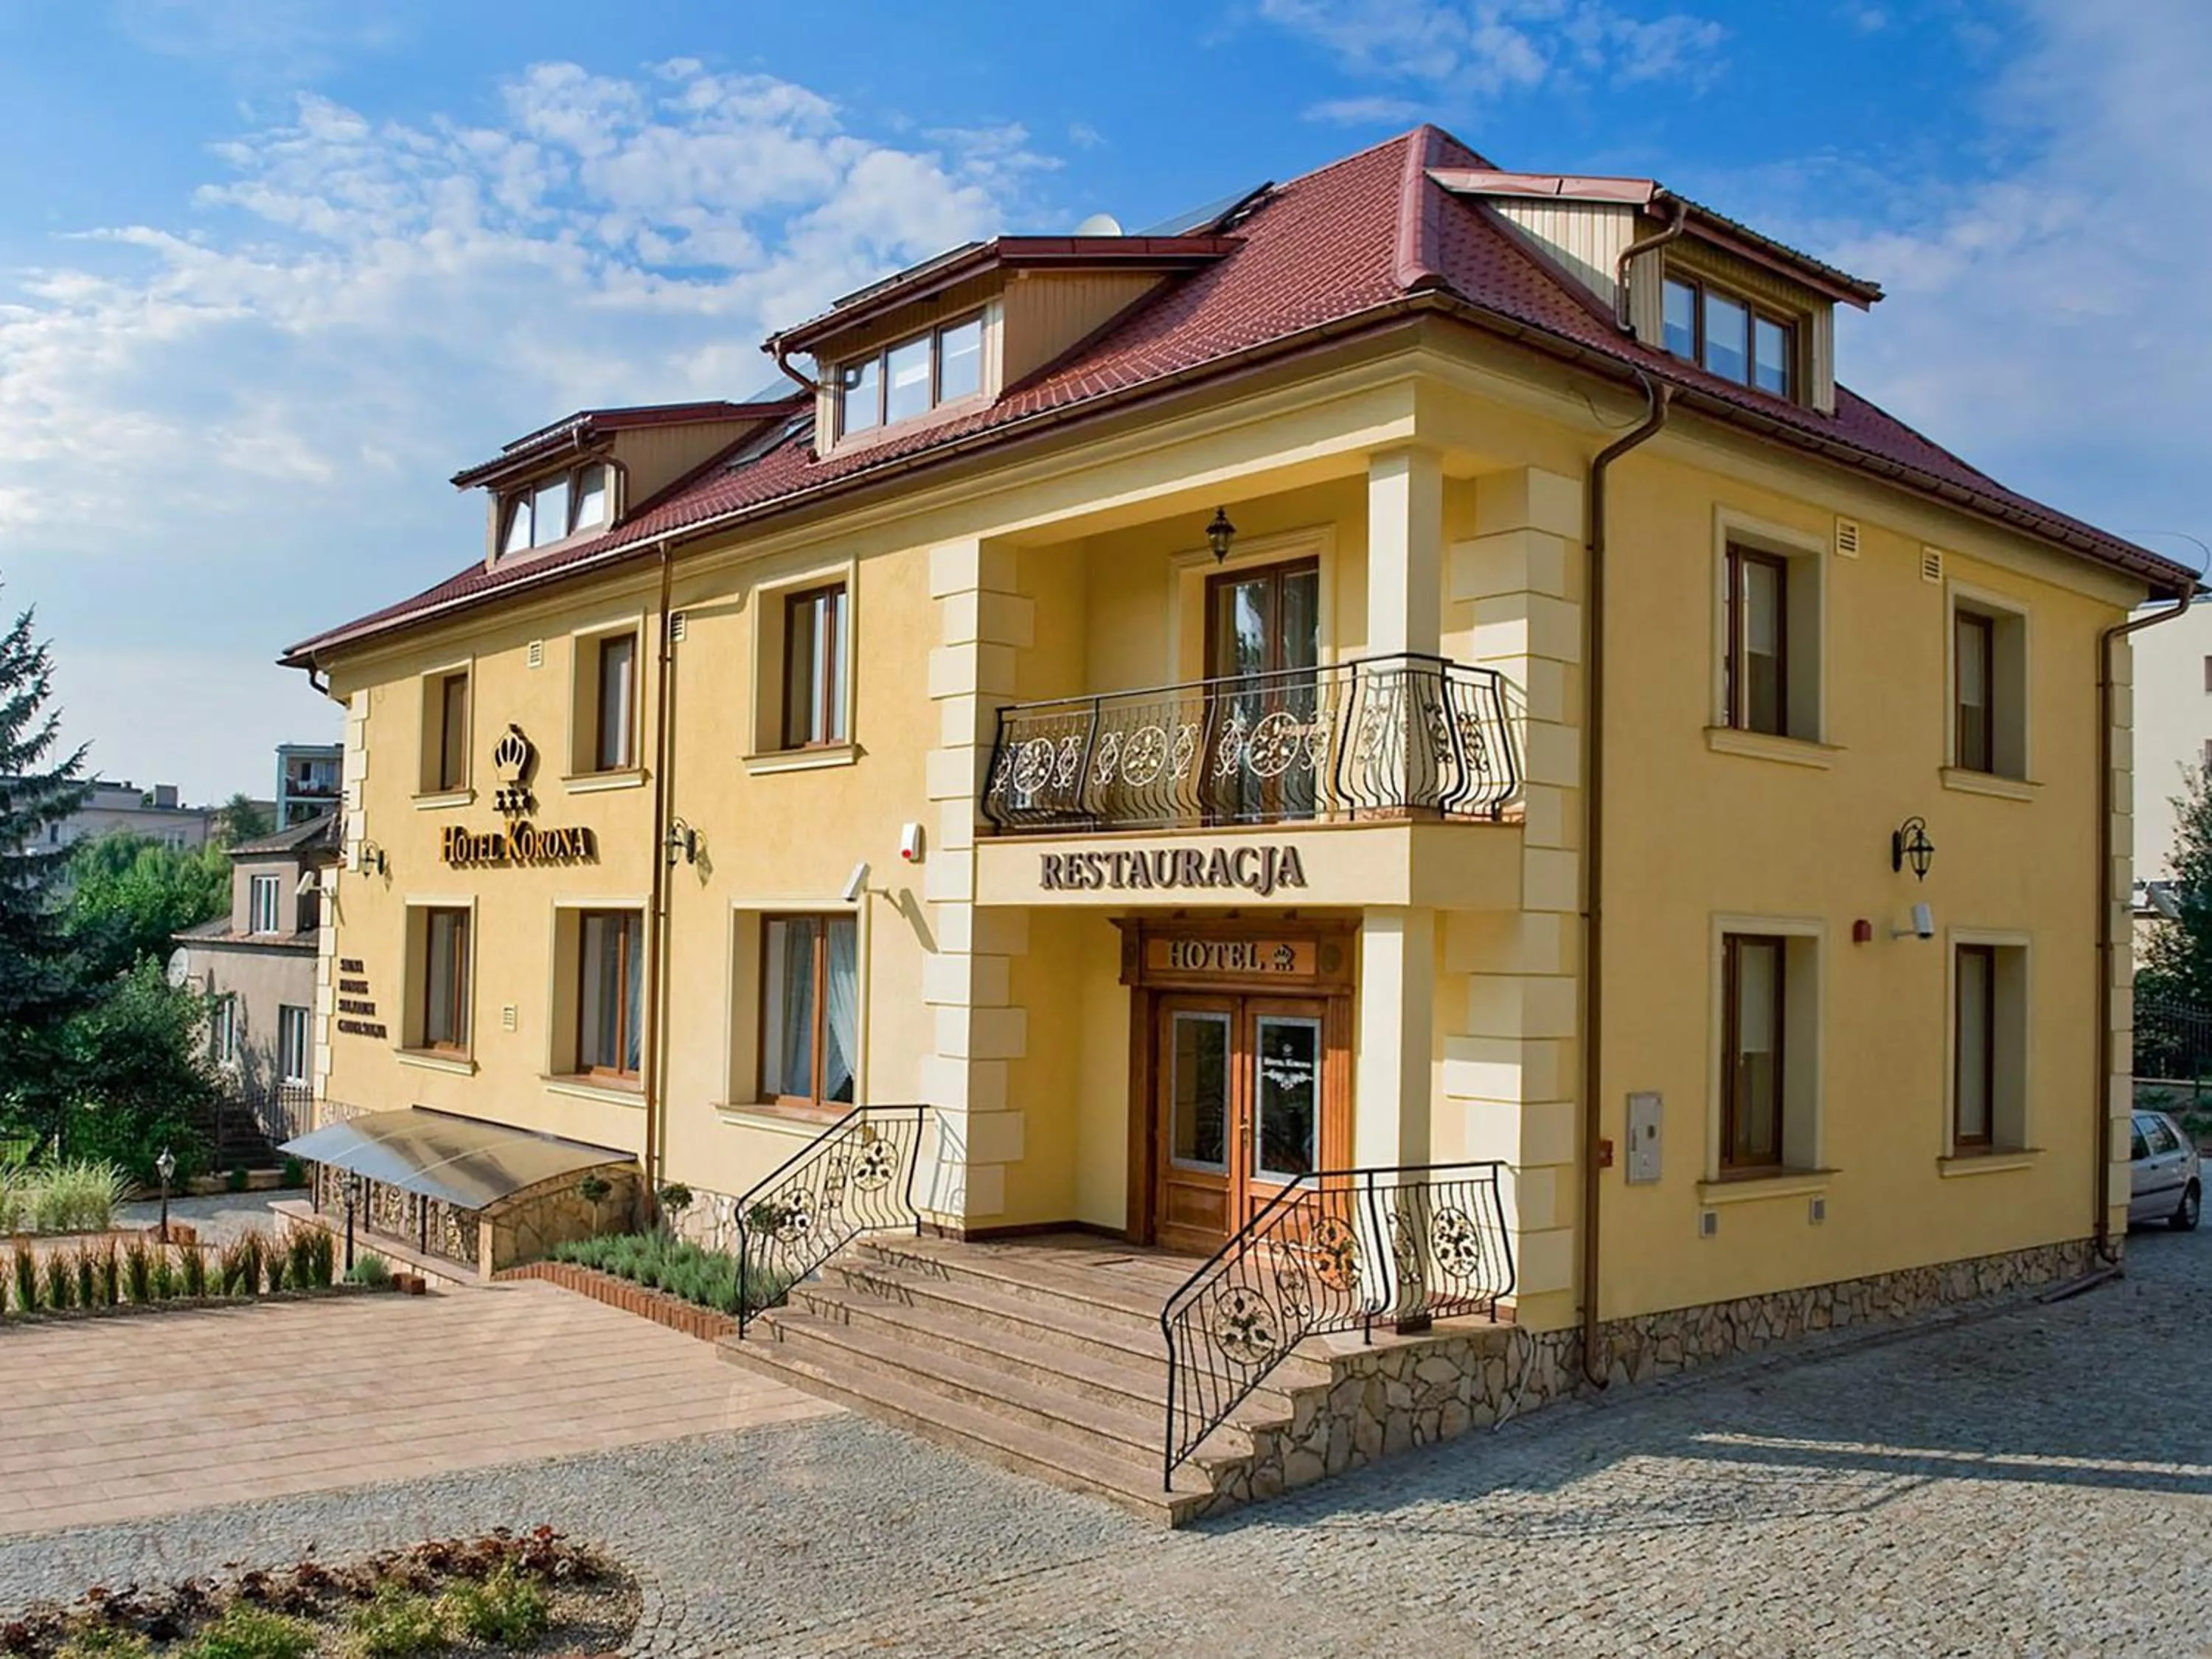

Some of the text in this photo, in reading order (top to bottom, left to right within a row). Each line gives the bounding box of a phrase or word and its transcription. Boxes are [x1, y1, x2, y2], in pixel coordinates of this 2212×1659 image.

[439, 819, 590, 863] HOTEL KORONA
[1040, 846, 1307, 895] RESTAURACJA
[1169, 939, 1265, 971] HOTEL
